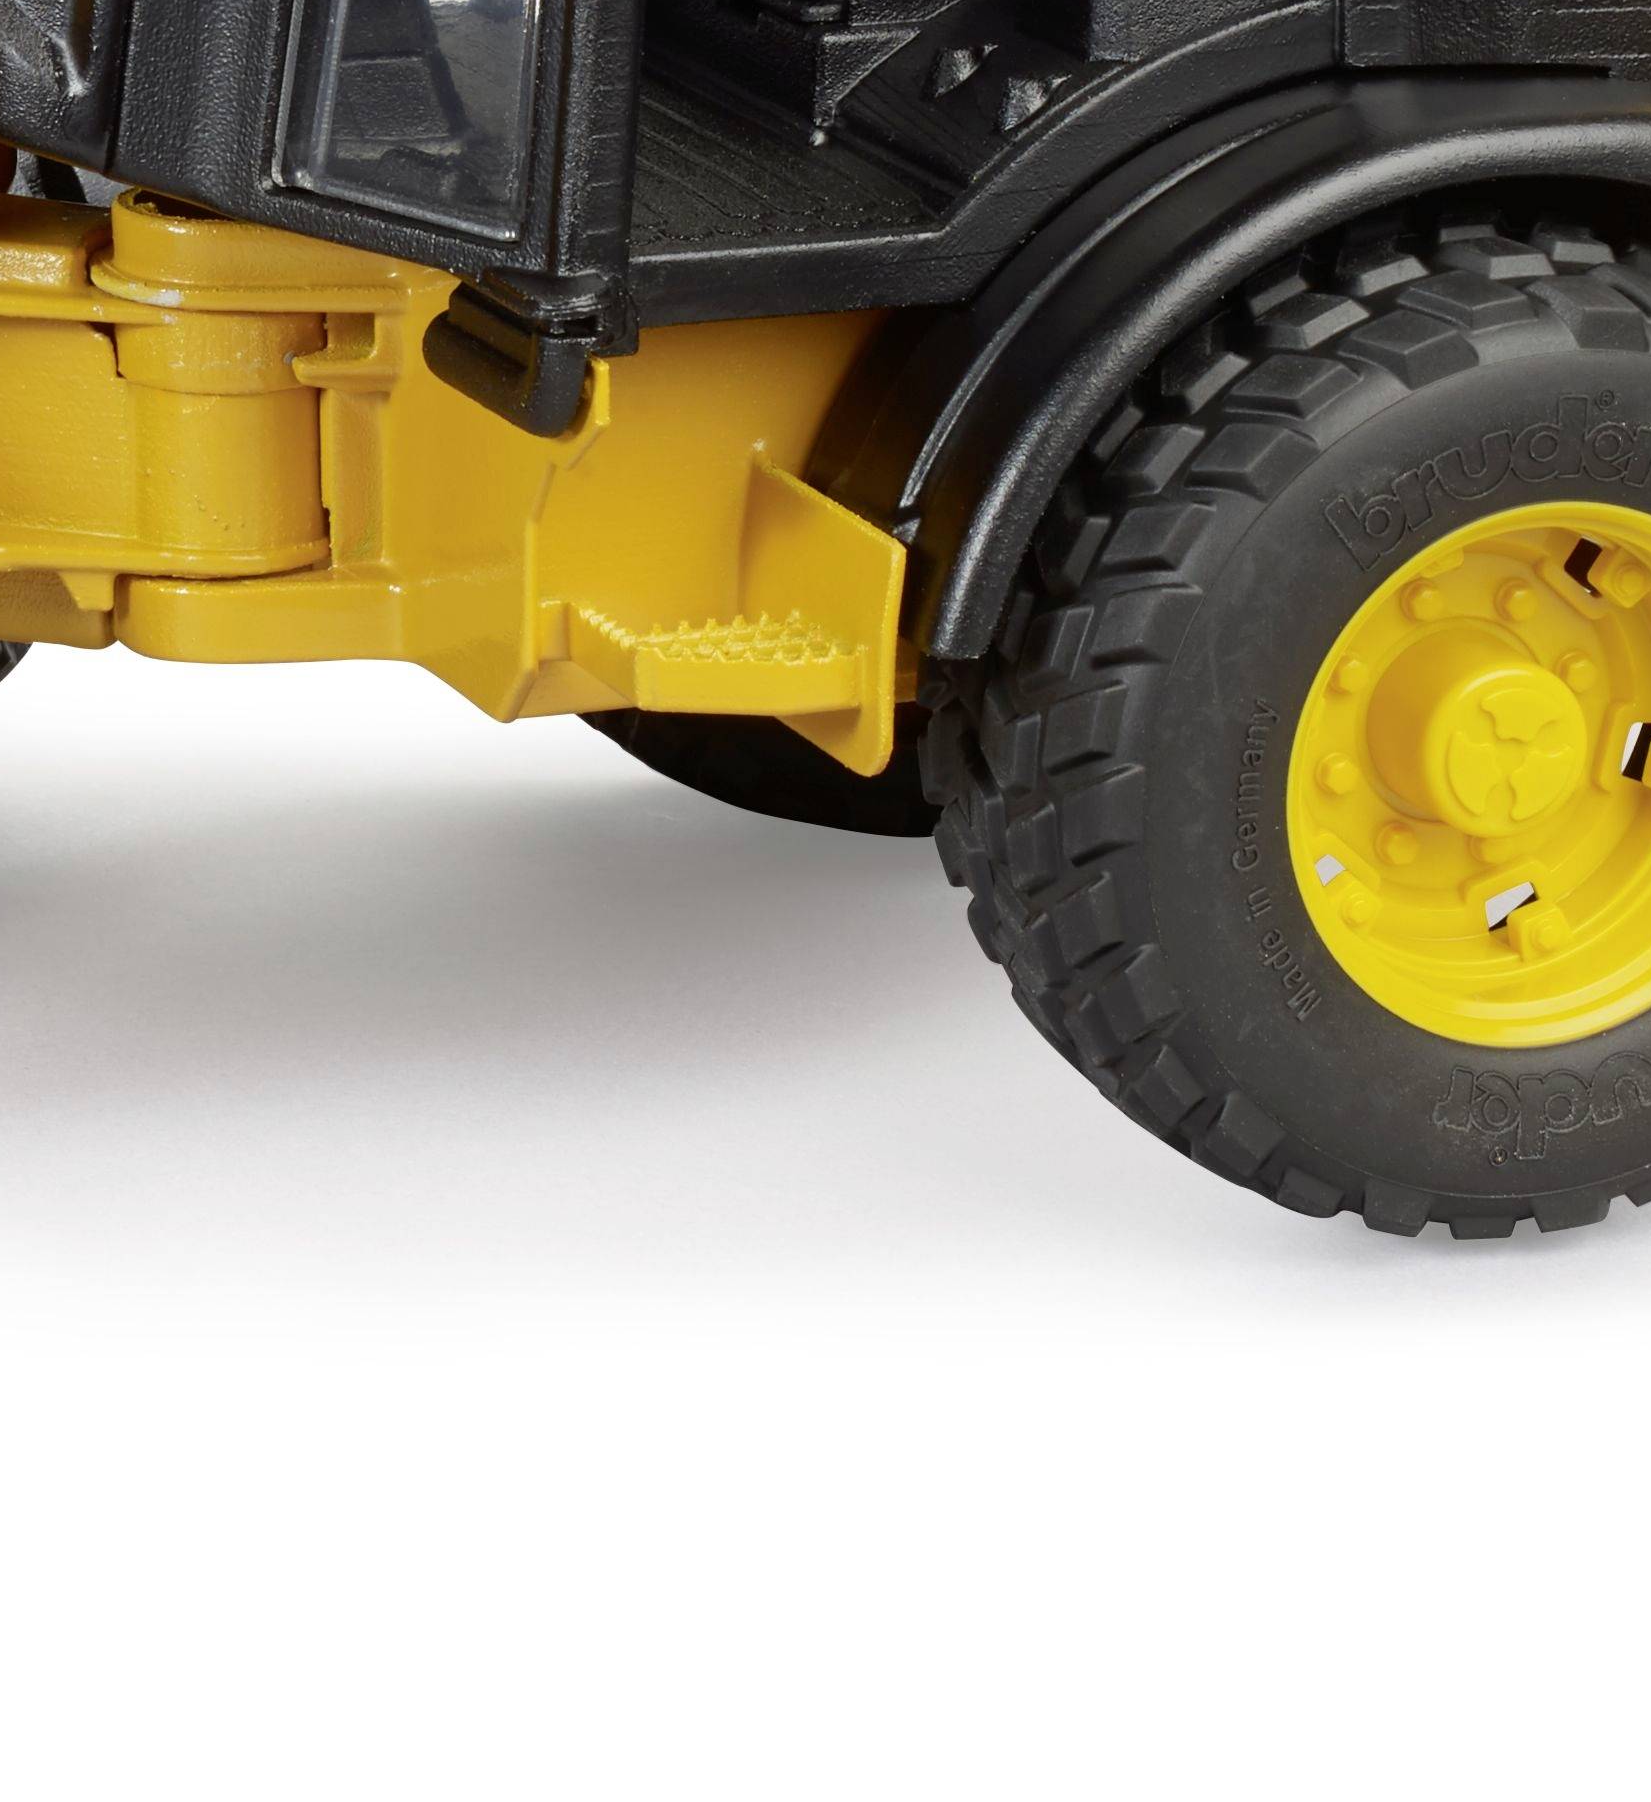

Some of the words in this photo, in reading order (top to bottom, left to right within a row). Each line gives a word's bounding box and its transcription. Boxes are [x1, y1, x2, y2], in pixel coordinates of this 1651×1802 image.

[1232, 697, 1281, 873] Germany
[1246, 886, 1274, 918] in
[1261, 929, 1322, 1022] Made
